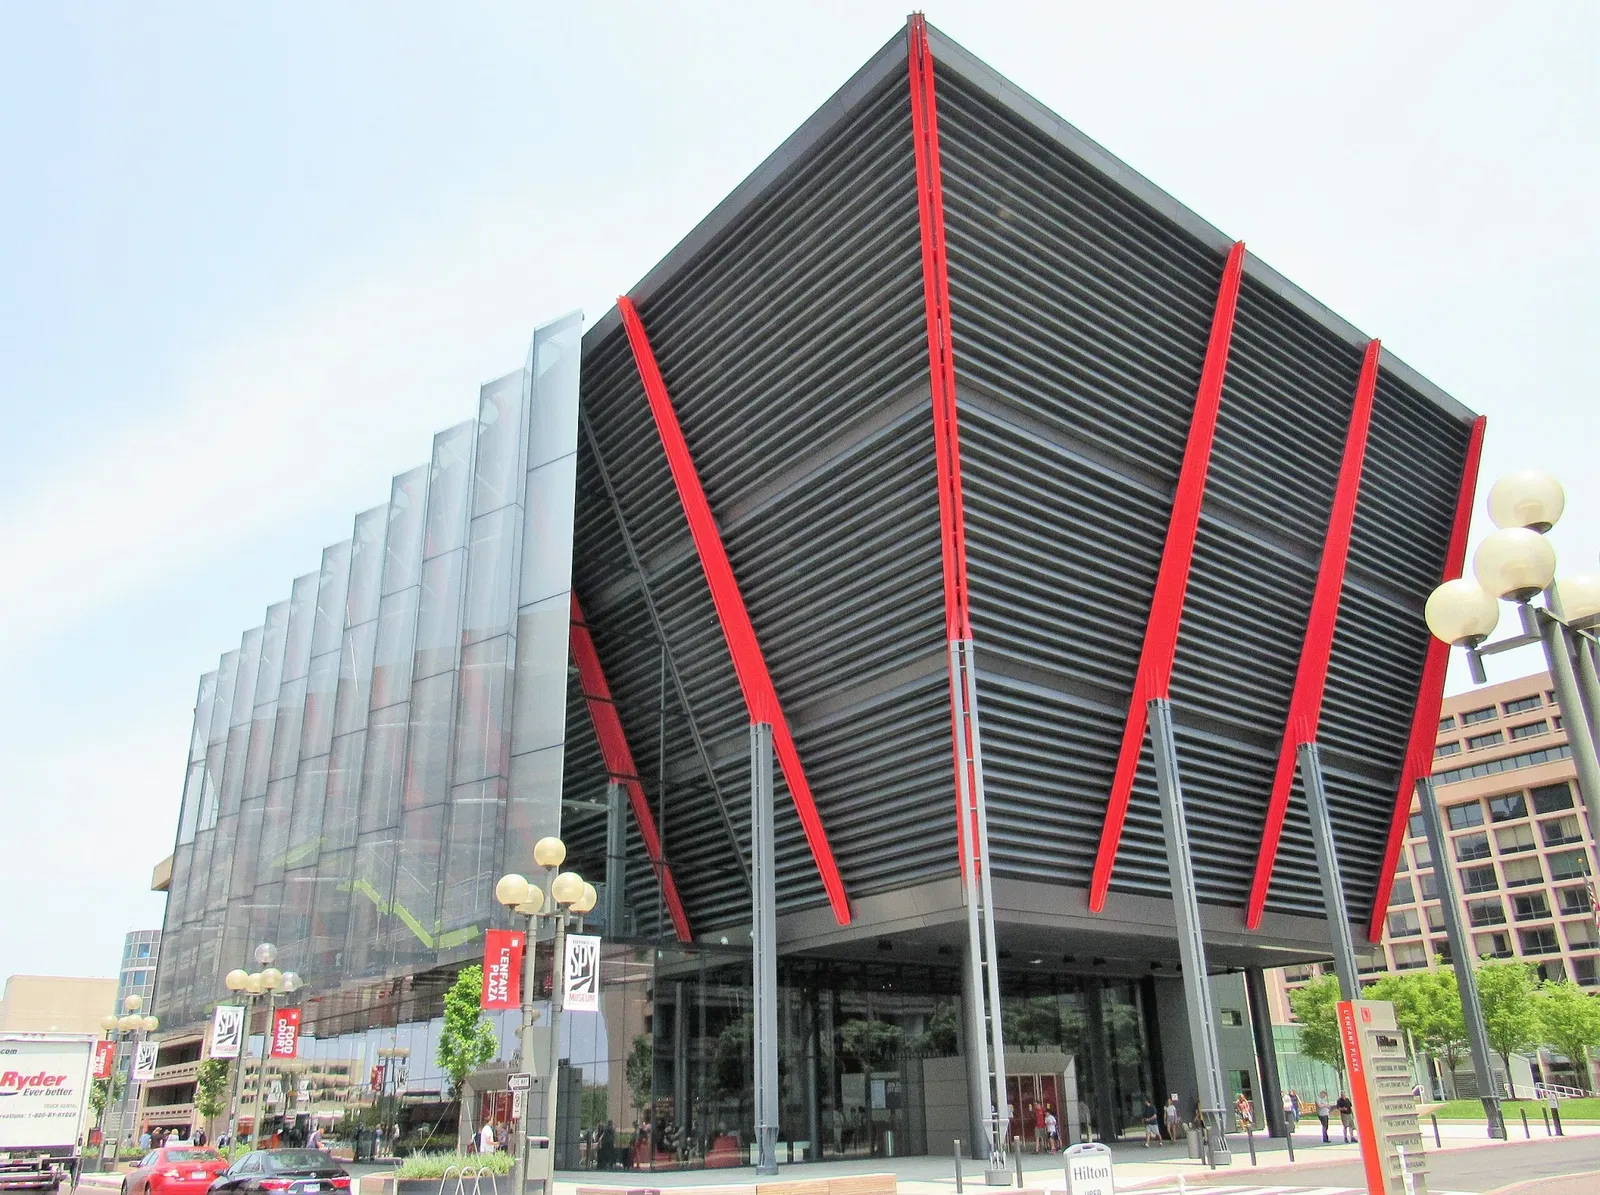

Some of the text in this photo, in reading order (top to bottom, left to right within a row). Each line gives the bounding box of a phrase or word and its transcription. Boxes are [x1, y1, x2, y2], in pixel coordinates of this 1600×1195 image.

[570, 945, 596, 977] SPY
[487, 964, 499, 1002] PLAZA
[497, 947, 510, 1002] L'ENFANT
[569, 993, 595, 1002] MUSEUM
[218, 1011, 239, 1035] SPY
[275, 1018, 287, 1053] COURT
[283, 1025, 295, 1054] FOOD
[1343, 1009, 1360, 1072] L'ENFANT PLAZA
[139, 1045, 155, 1063] SPY
[0, 1071, 67, 1091] Ryder
[23, 1087, 73, 1096] Ever better.
[1073, 1165, 1109, 1181] Hilton
